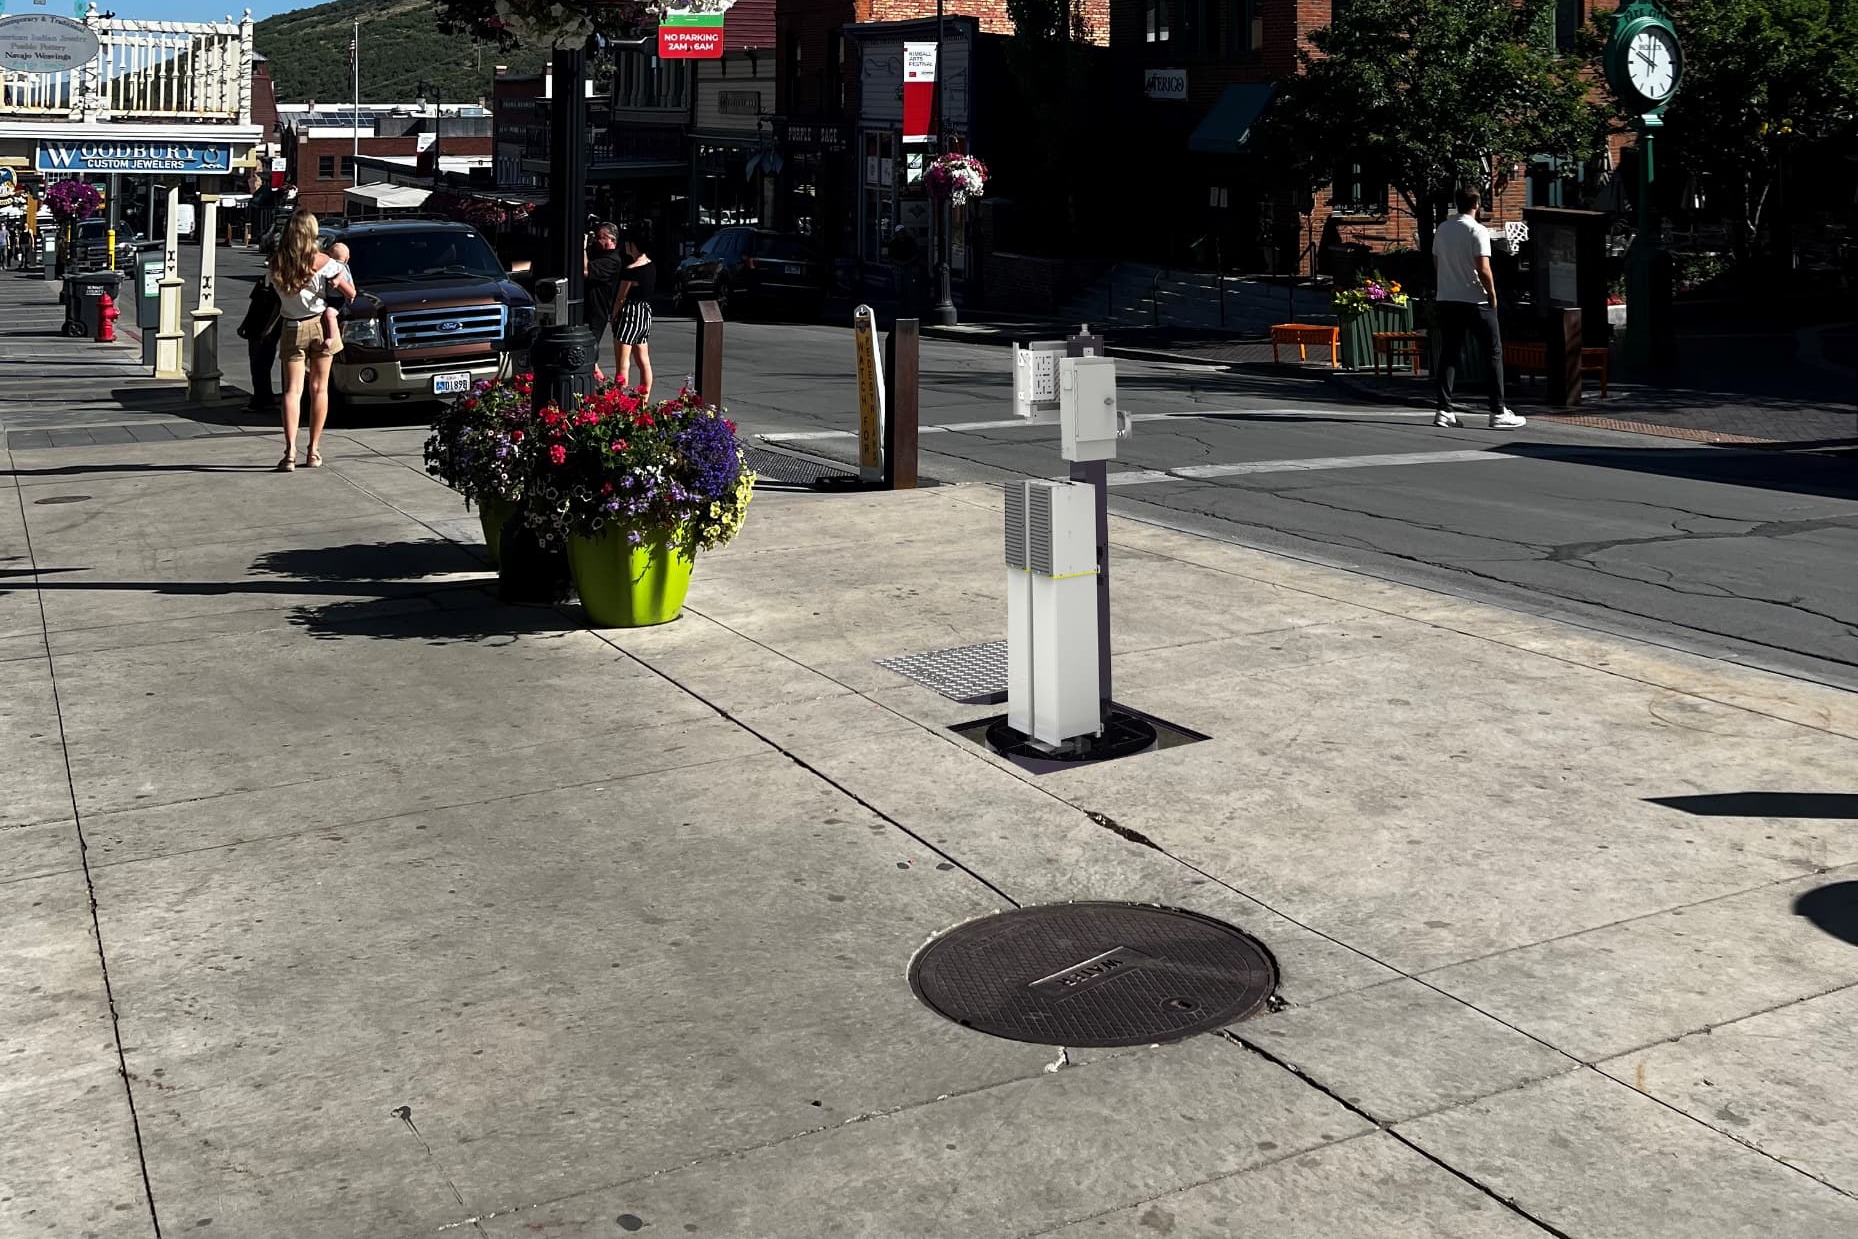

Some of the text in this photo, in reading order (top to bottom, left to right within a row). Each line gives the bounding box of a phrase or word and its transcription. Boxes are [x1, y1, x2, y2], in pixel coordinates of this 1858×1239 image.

[31, 33, 57, 41] Indian
[664, 33, 719, 42] NO PARKING
[40, 43, 67, 53] Pottery
[668, 42, 688, 51] 2AM
[693, 42, 714, 51] 6AM
[5, 51, 72, 62] Navajo Weavings
[45, 140, 195, 167] WOODBURY
[87, 159, 185, 169] CUSTOM JEWELERS
[858, 343, 867, 405] WATCH
[1056, 958, 1125, 987] WATER
